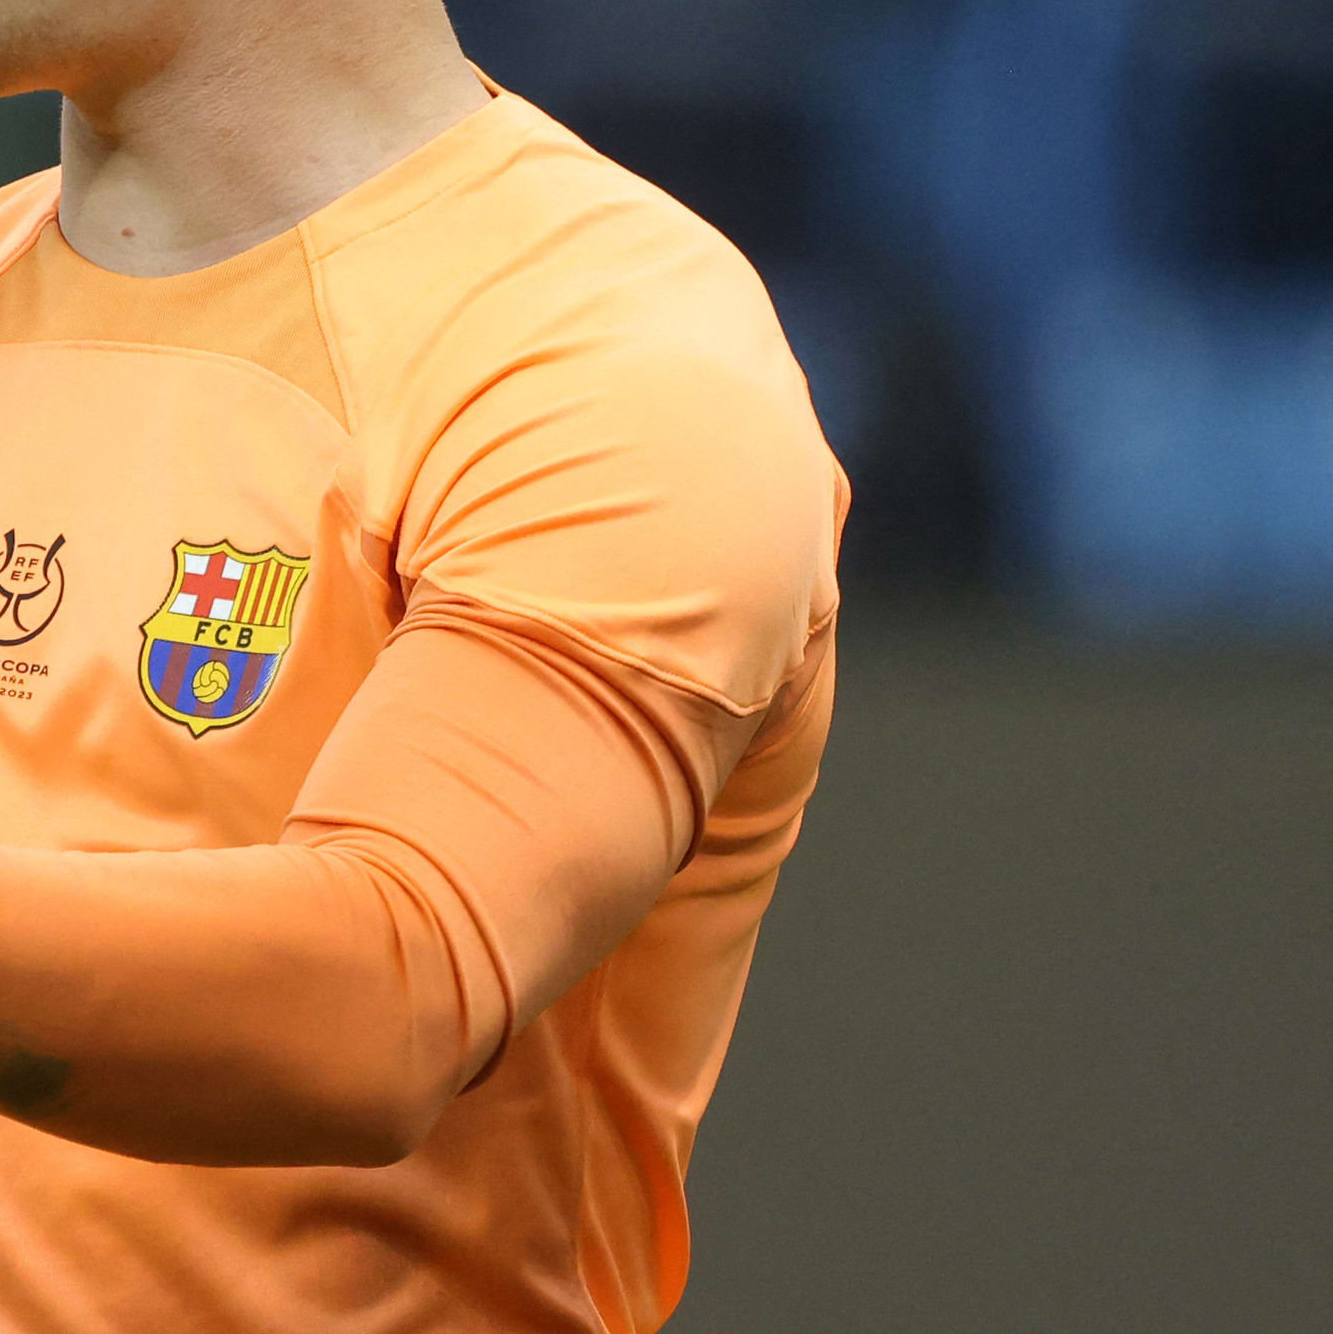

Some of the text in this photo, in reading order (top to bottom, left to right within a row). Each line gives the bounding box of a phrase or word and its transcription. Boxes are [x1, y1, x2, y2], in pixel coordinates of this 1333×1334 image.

[14, 556, 40, 569] RF
[9, 570, 35, 582] EF
[193, 621, 253, 648] FCB
